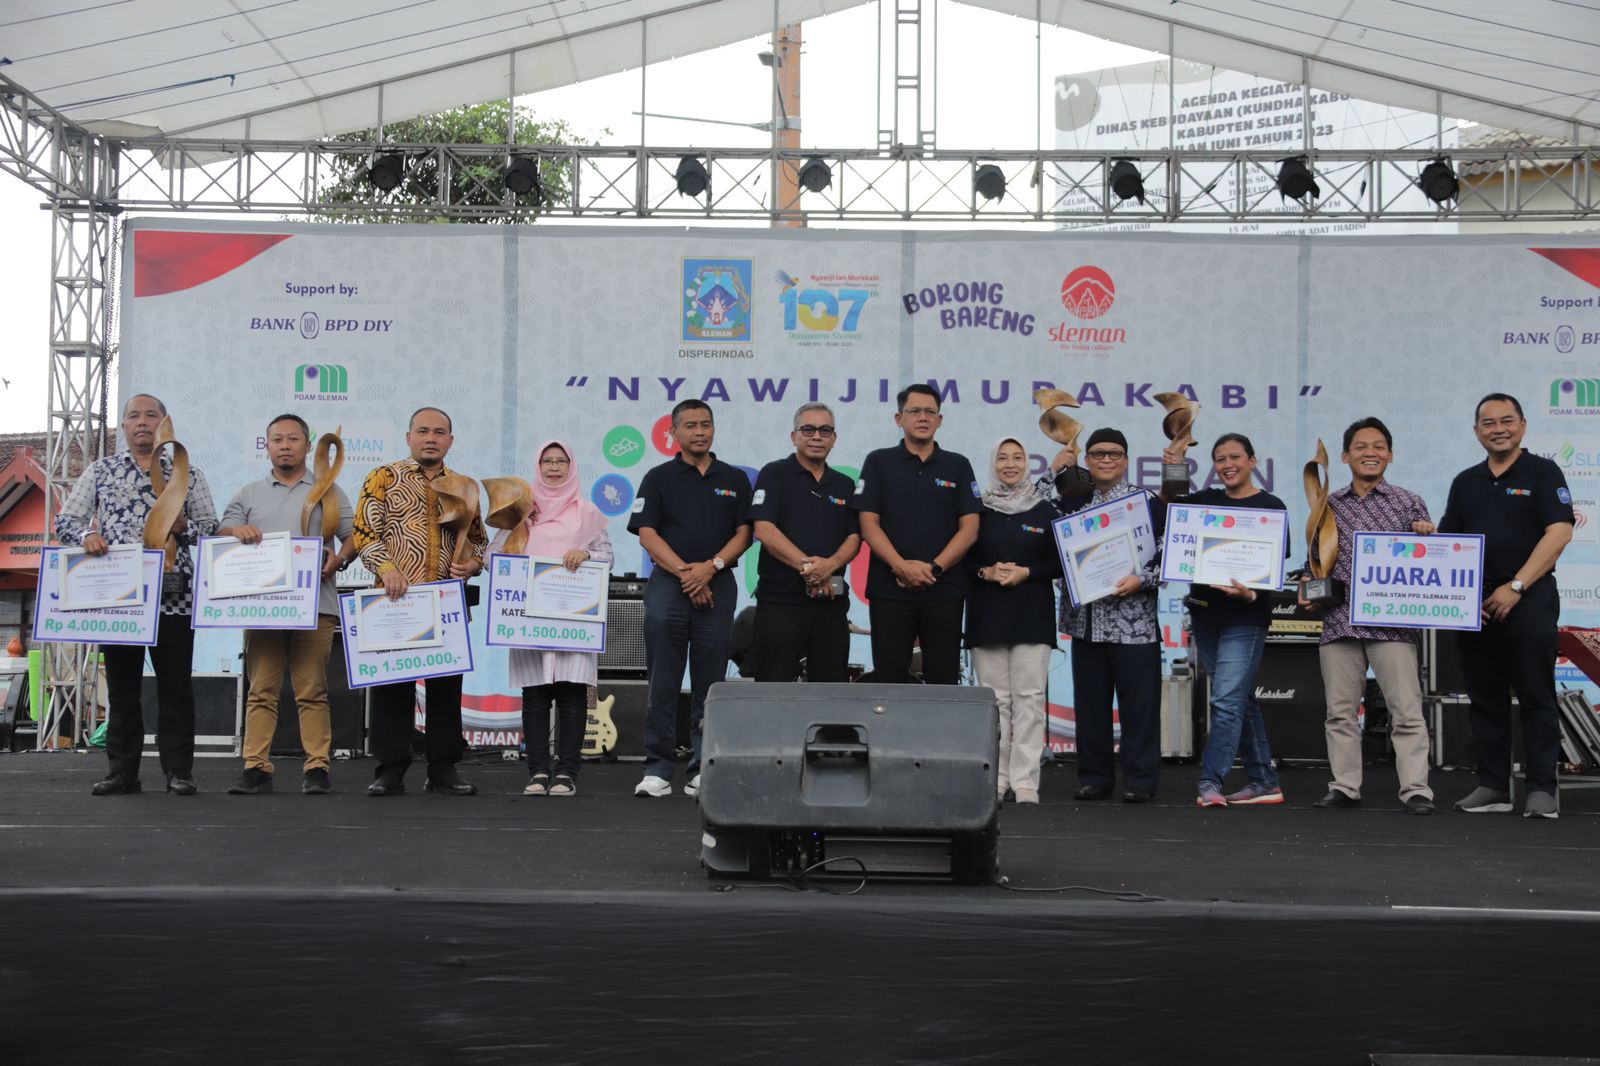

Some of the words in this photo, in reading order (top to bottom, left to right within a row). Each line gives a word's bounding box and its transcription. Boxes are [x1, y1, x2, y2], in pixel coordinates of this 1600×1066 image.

[1180, 91, 1237, 109] AGENDA
[1241, 83, 1302, 99] KEGIATA
[1096, 121, 1137, 135] DINAS
[1236, 97, 1303, 118] (KUNDHA
[1177, 120, 1253, 140] KABUPTEN
[1211, 138, 1240, 150] JUNI
[1244, 130, 1293, 147] TAHUN
[285, 283, 335, 297] Support
[339, 283, 358, 298] by:
[903, 281, 1004, 315] BORONG
[779, 288, 870, 331] 107
[1540, 296, 1593, 311] Support
[250, 318, 296, 331] BANK
[325, 320, 359, 332] BPD
[363, 320, 393, 332] DIY
[940, 306, 1036, 336] BARENG
[1047, 322, 1126, 343] sleman
[1503, 332, 1550, 345] BANK
[1581, 332, 1600, 345] BP
[678, 349, 754, 359] DISPERINDAG
[1549, 408, 1572, 416] PDAM
[1575, 408, 1600, 416] SLEMA
[1360, 566, 1442, 587] JUARA
[1450, 568, 1474, 588] III
[203, 606, 222, 620] Rp
[227, 606, 307, 620] 3.000.000,-
[501, 608, 526, 617] KATE
[1362, 602, 1380, 617] Rp
[1386, 603, 1469, 620] 2.000.000,-
[45, 618, 63, 632] Rp
[67, 619, 147, 636] 4.000.000,-
[497, 624, 515, 638] Rp
[520, 625, 595, 642] 1.500.000,-
[359, 663, 378, 677] Rp
[383, 652, 462, 673] 1.500.000,-
[1254, 686, 1296, 699] Marshall
[462, 731, 519, 746] LEMAN
